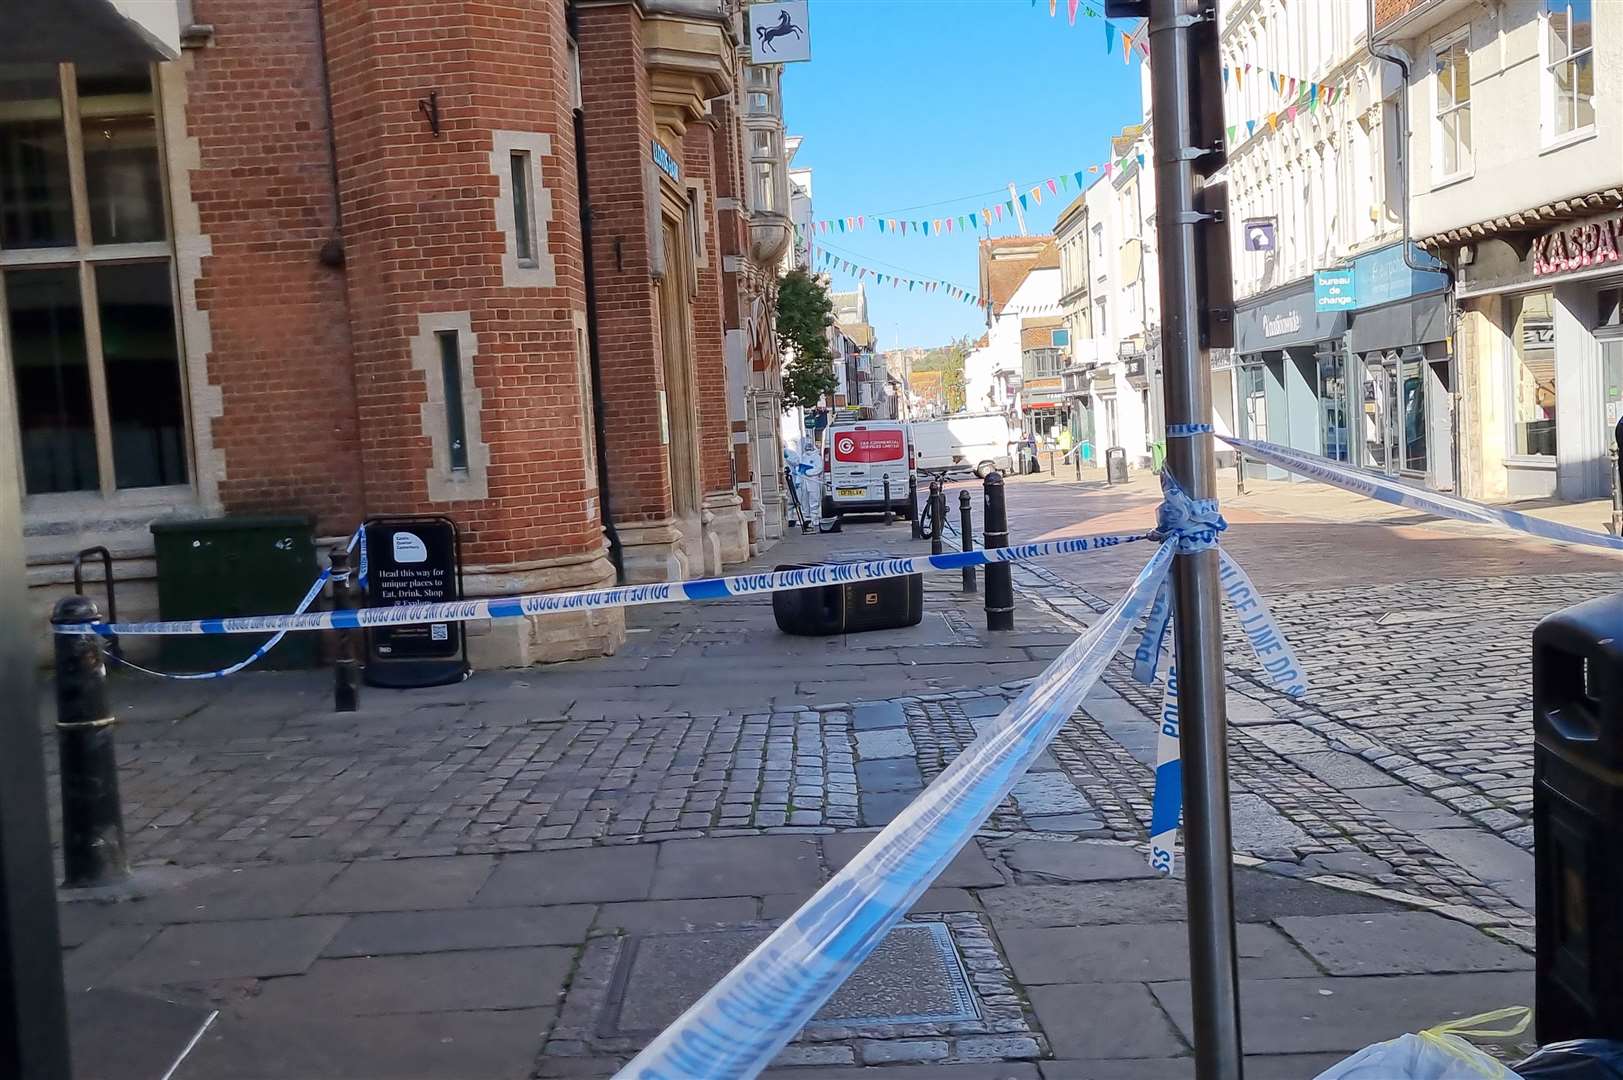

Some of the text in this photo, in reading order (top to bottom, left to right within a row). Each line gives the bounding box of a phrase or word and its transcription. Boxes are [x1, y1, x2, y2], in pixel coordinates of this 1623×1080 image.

[1319, 276, 1350, 286] bureau
[1329, 286, 1341, 295] de
[1318, 296, 1352, 305] change
[379, 570, 398, 578] Head
[400, 569, 414, 577] this
[778, 570, 800, 586] NOT
[382, 580, 408, 588] unique
[410, 579, 433, 588] places
[734, 573, 775, 592] CROSS
[424, 590, 443, 598] Shop
[527, 597, 560, 612] CROSS
[562, 595, 584, 608] NOT
